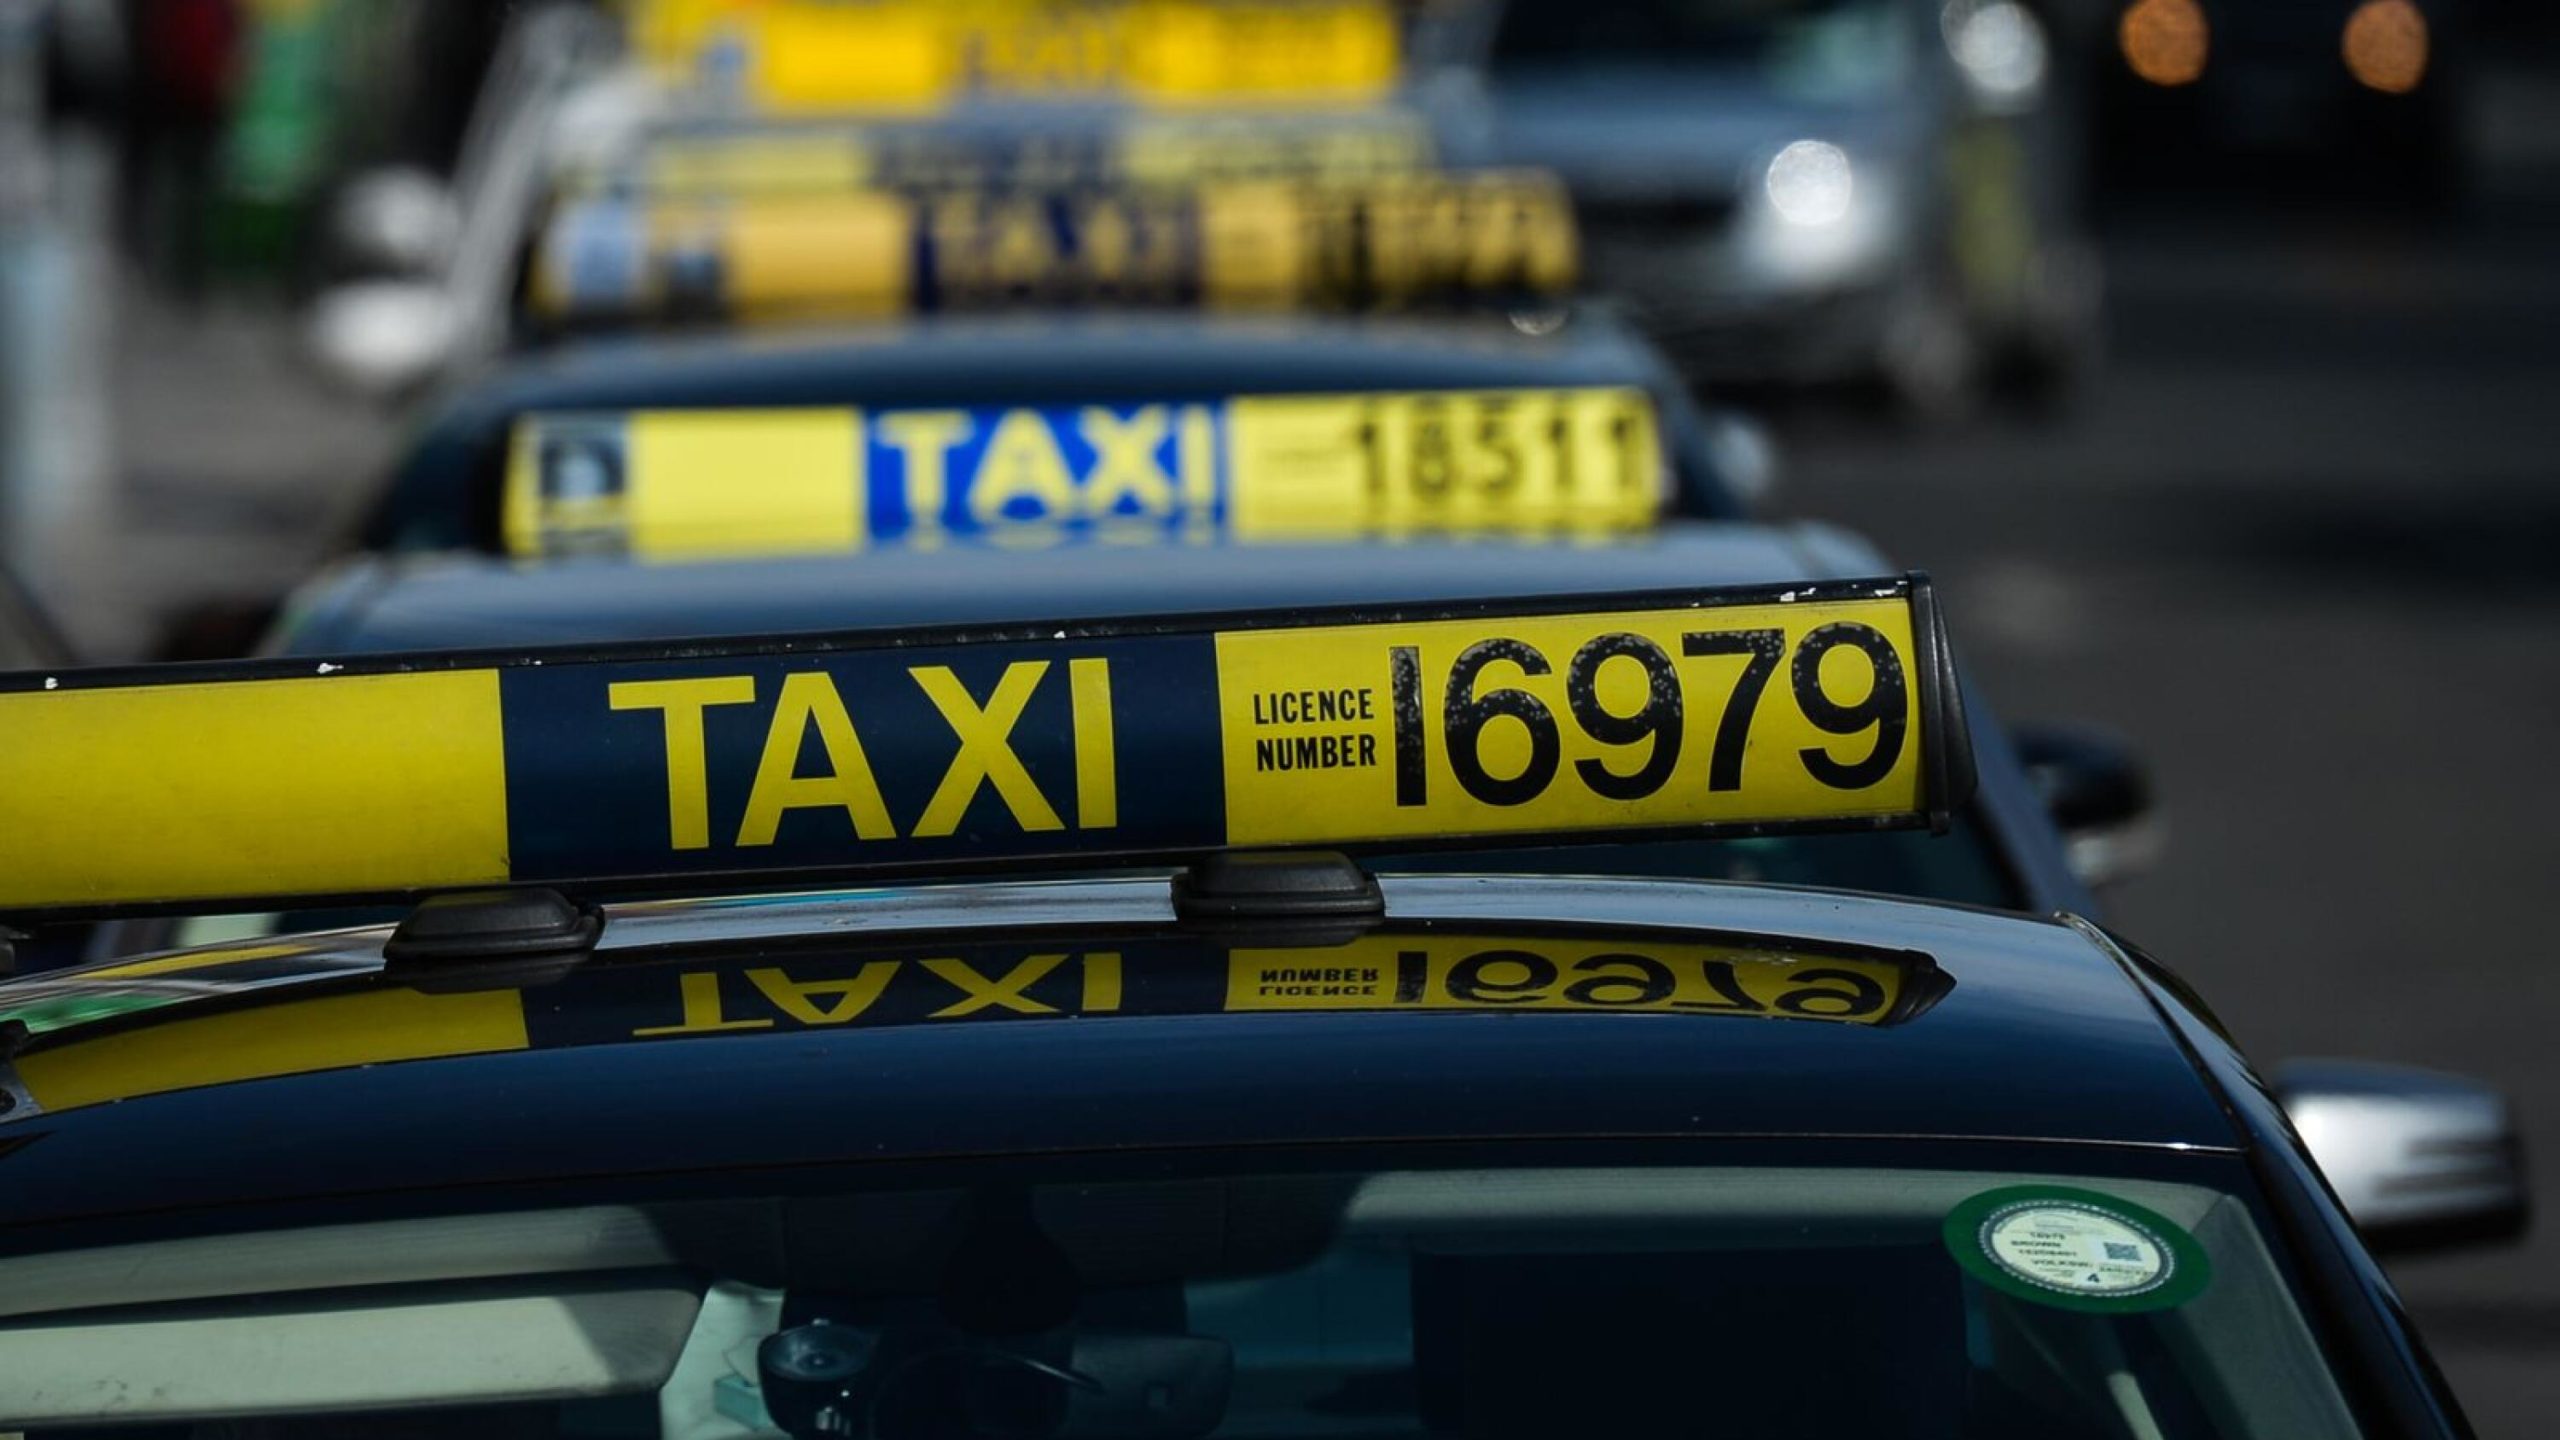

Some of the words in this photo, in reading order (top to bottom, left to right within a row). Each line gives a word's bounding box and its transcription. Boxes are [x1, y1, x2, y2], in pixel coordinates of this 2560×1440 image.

[876, 404, 1214, 520] TAXI
[1350, 399, 1640, 500] 18511
[608, 657, 1118, 850] TAXI
[1253, 689, 1374, 725] LICENCE
[1256, 733, 1376, 772] NUMBER
[1389, 621, 1909, 806] 16979
